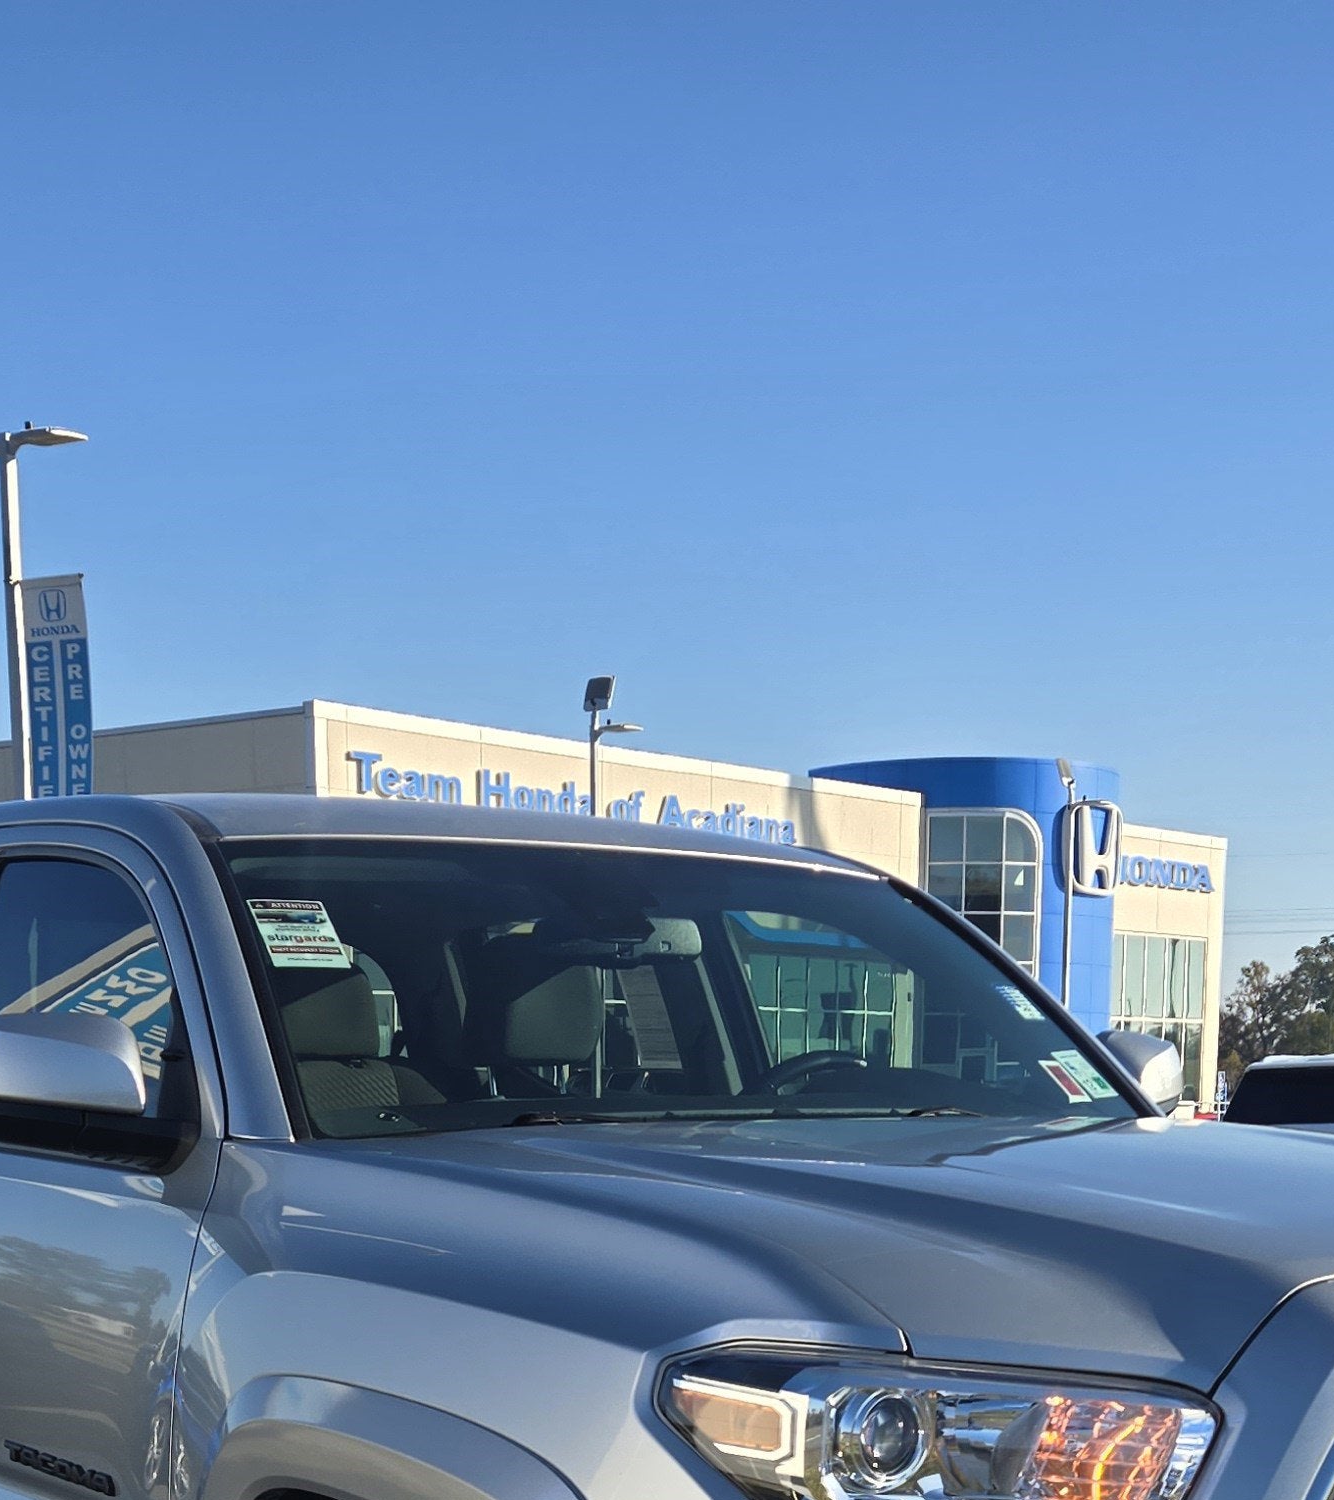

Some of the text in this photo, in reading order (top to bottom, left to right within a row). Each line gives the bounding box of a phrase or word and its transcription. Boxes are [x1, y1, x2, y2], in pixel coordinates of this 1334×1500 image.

[30, 624, 80, 637] HONDA
[67, 643, 84, 700] PRE
[346, 750, 796, 845] Team Honda of Acadiana
[270, 902, 321, 910] ATTENTION
[4, 1440, 116, 1497] TACOMA
